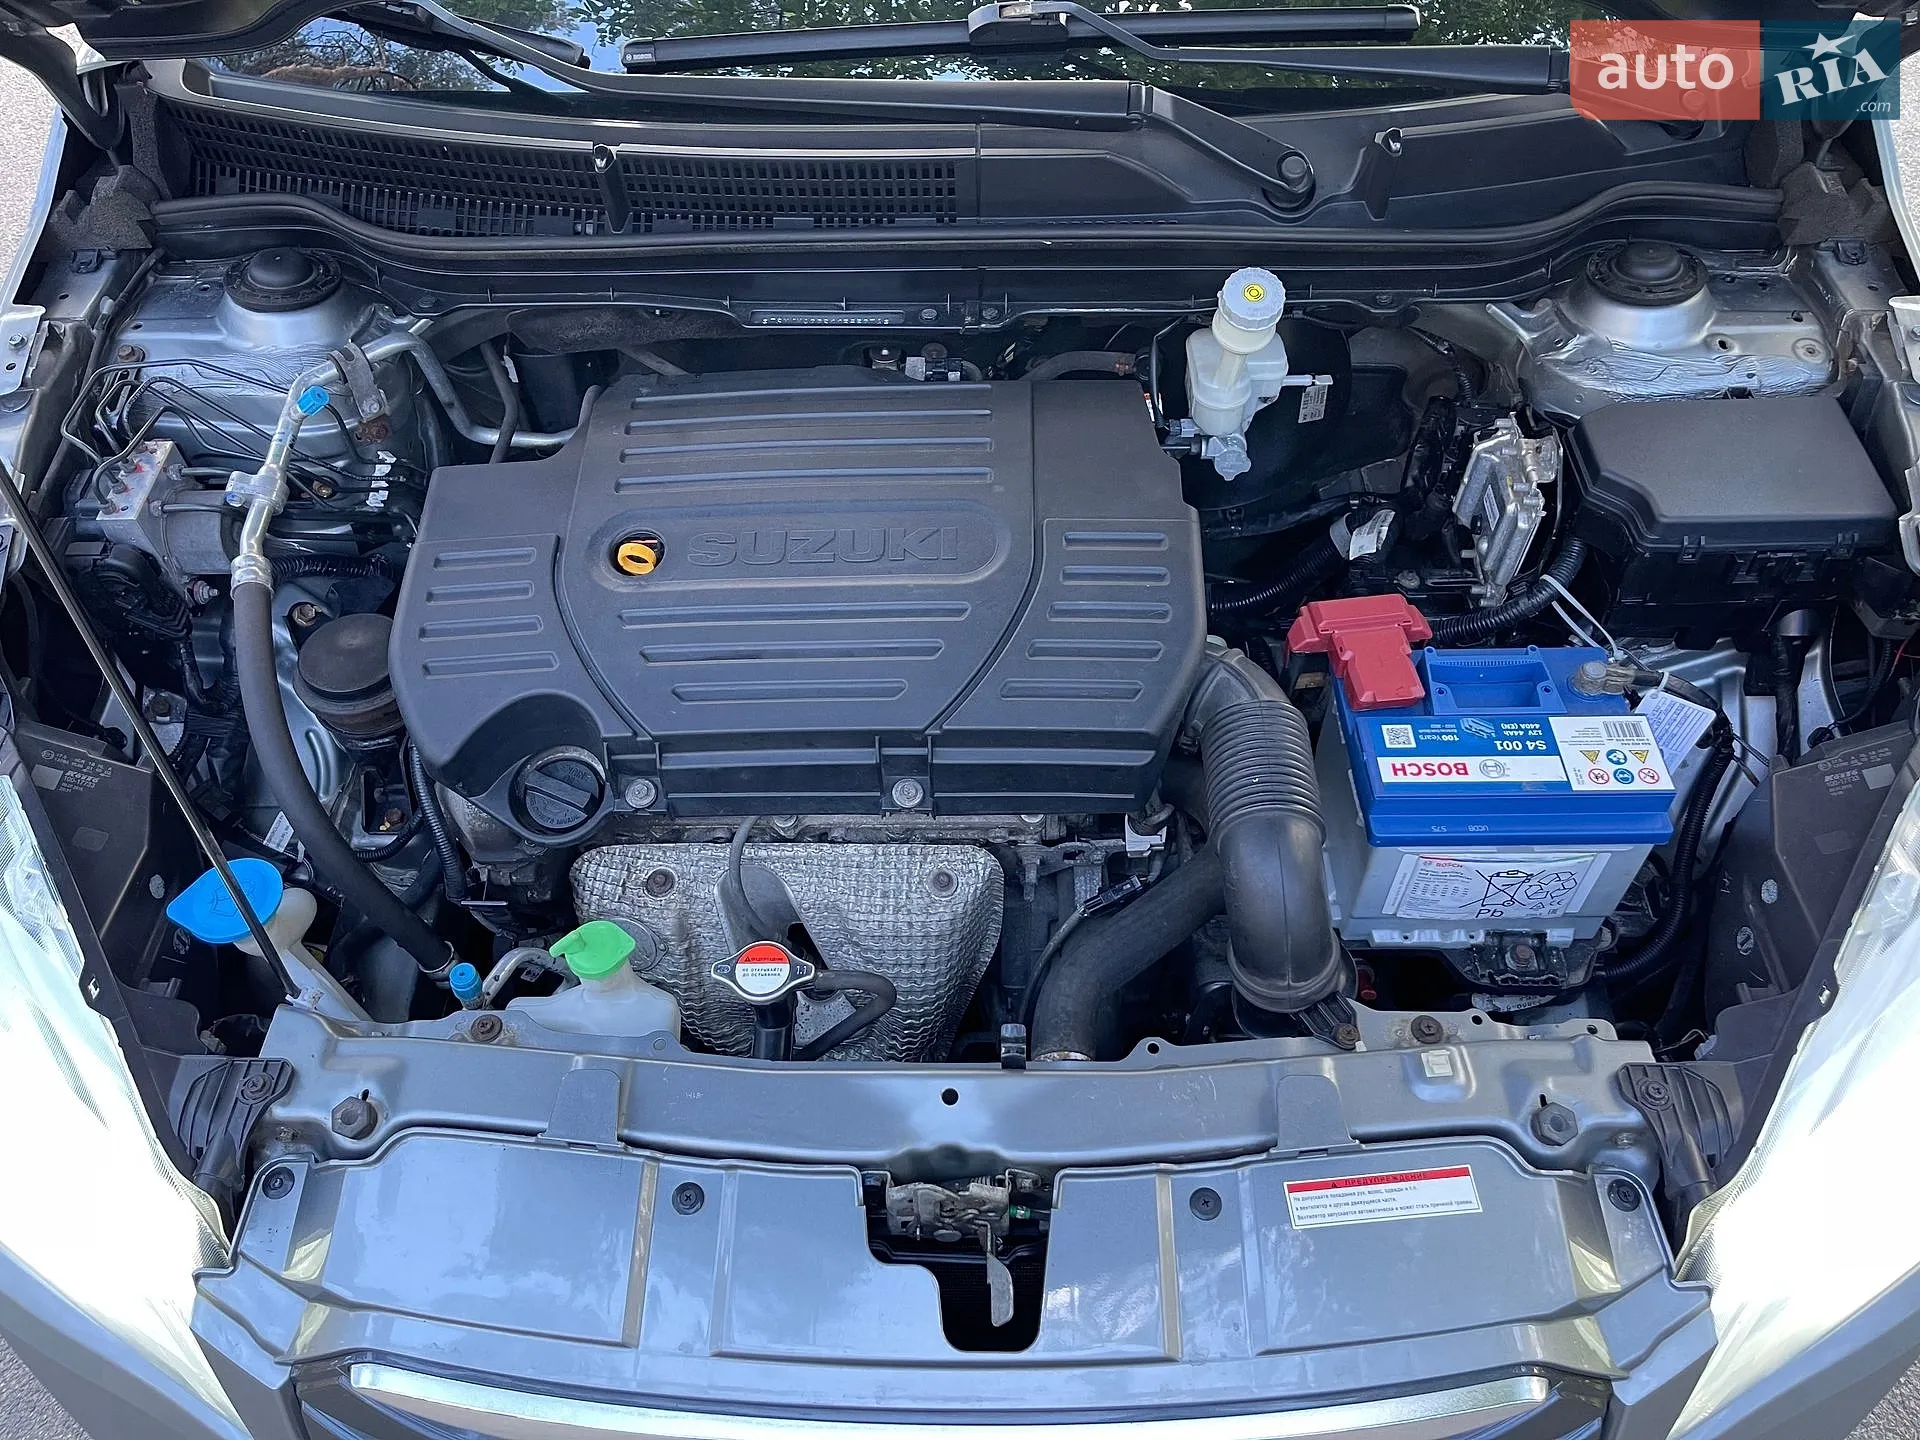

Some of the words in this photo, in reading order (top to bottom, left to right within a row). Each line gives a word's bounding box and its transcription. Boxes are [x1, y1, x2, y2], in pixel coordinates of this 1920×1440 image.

[687, 526, 958, 567] SUZUKI
[1493, 740, 1523, 751] 001
[1525, 740, 1547, 750] S4
[1391, 762, 1469, 776] BOSCH
[1476, 908, 1504, 918] Pb
